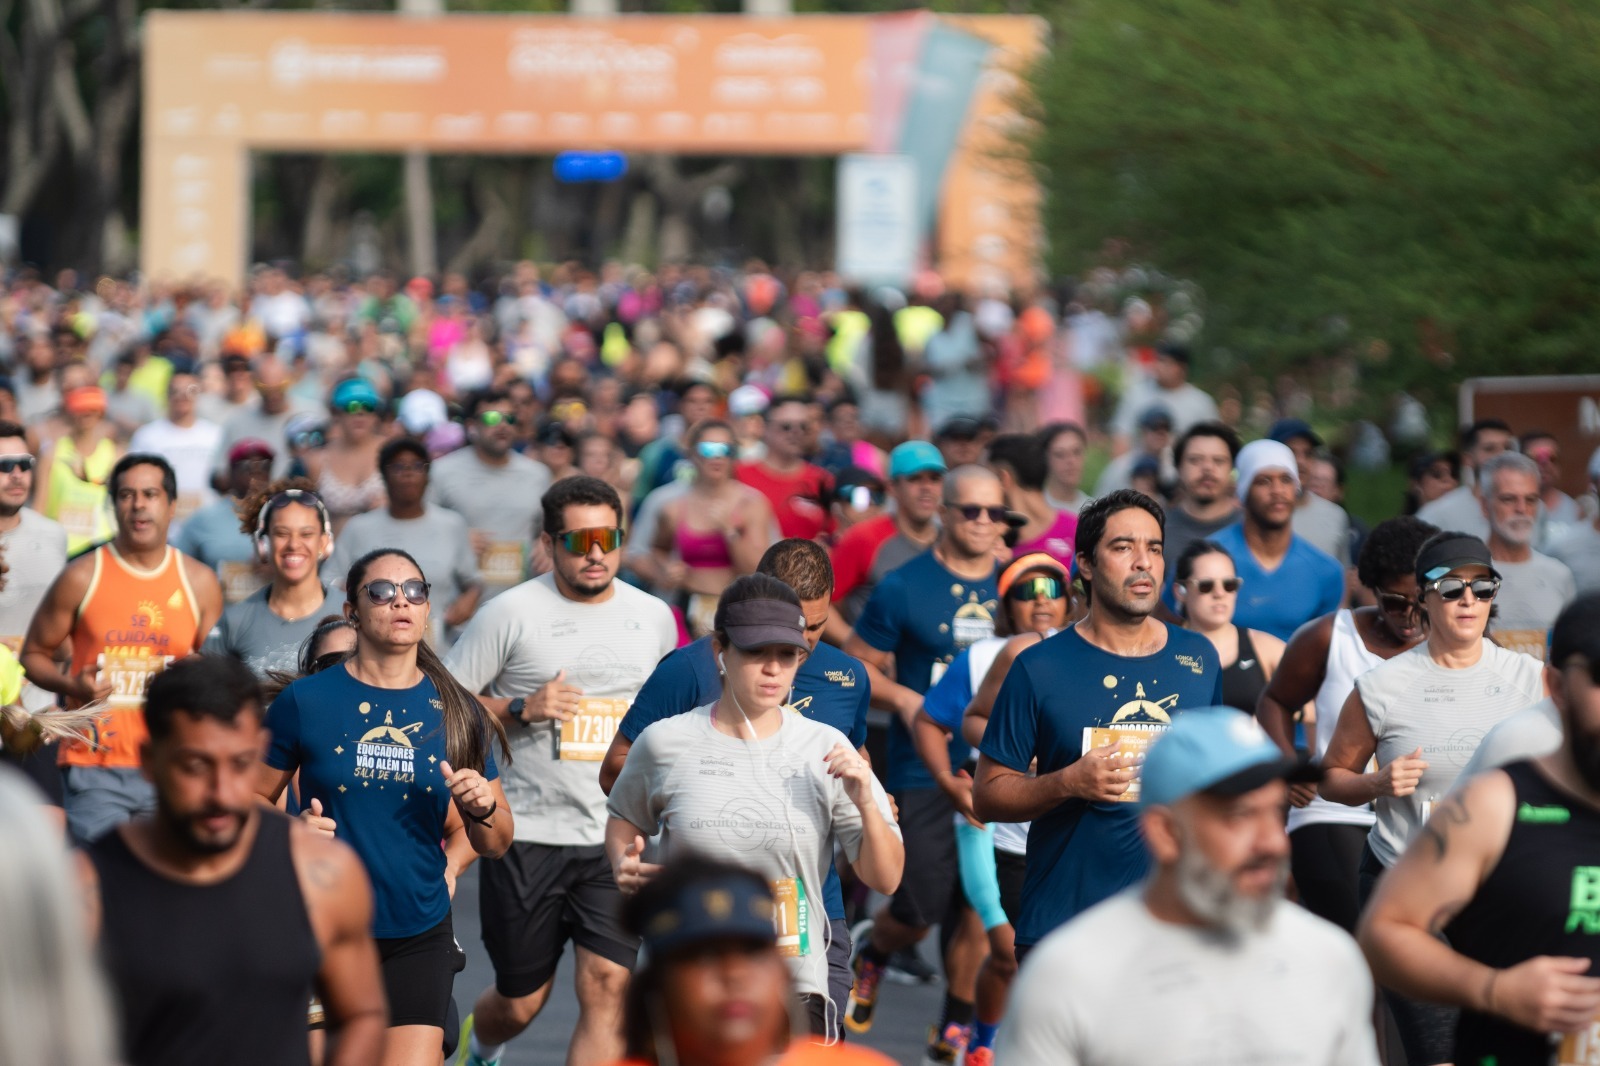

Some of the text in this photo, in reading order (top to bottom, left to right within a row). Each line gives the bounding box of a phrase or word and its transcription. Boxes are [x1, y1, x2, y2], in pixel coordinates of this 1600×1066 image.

[131, 614, 147, 627] SE
[105, 630, 170, 646] CUIDAR
[357, 743, 415, 760] EDUCADORES
[356, 755, 414, 773] VÃO ALÉM DA
[353, 767, 415, 783] SALA DE AULA
[690, 817, 738, 829] circuito
[755, 820, 806, 834] estaçes
[799, 899, 807, 934] VERDE
